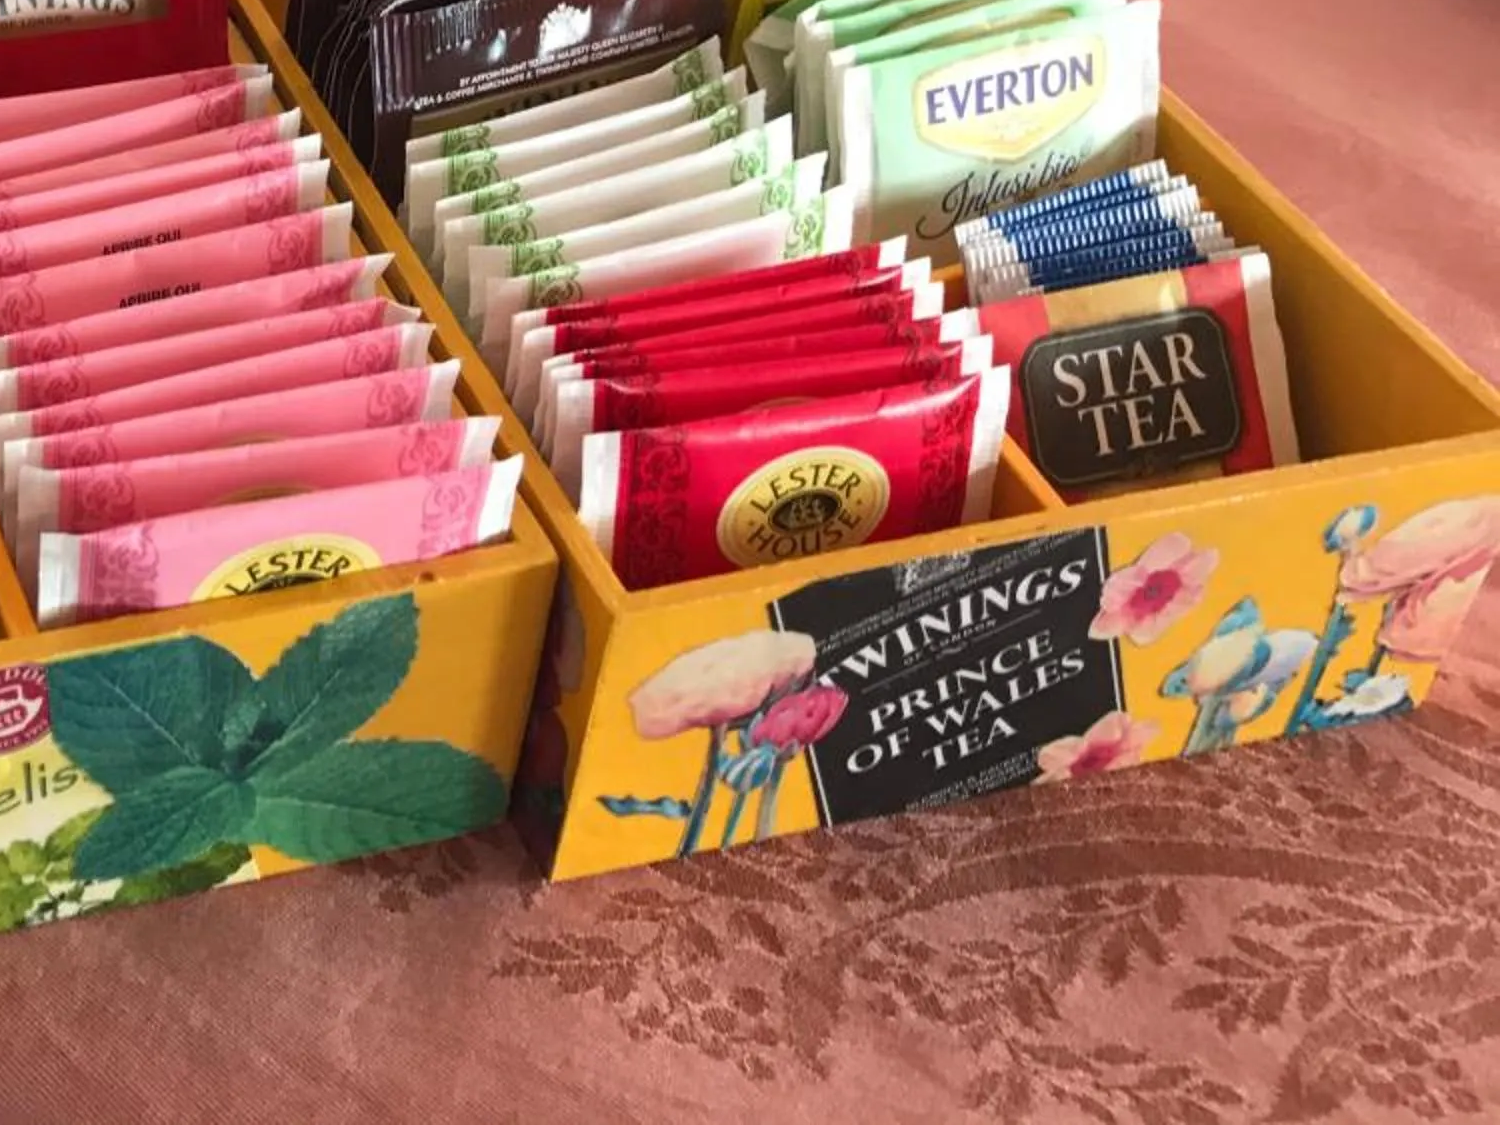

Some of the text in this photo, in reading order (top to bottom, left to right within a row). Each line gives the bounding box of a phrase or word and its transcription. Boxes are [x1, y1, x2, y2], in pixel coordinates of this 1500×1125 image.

[925, 53, 1094, 126] EVERTON
[1052, 332, 1206, 408] STAR
[1078, 388, 1206, 457] TEA
[750, 463, 861, 514] LESTER
[747, 508, 863, 557] HOUSE
[224, 549, 351, 596] LESTER
[846, 647, 1087, 774] OF WALES
[868, 628, 1056, 734] PRINCE
[920, 715, 1019, 771] TEA
